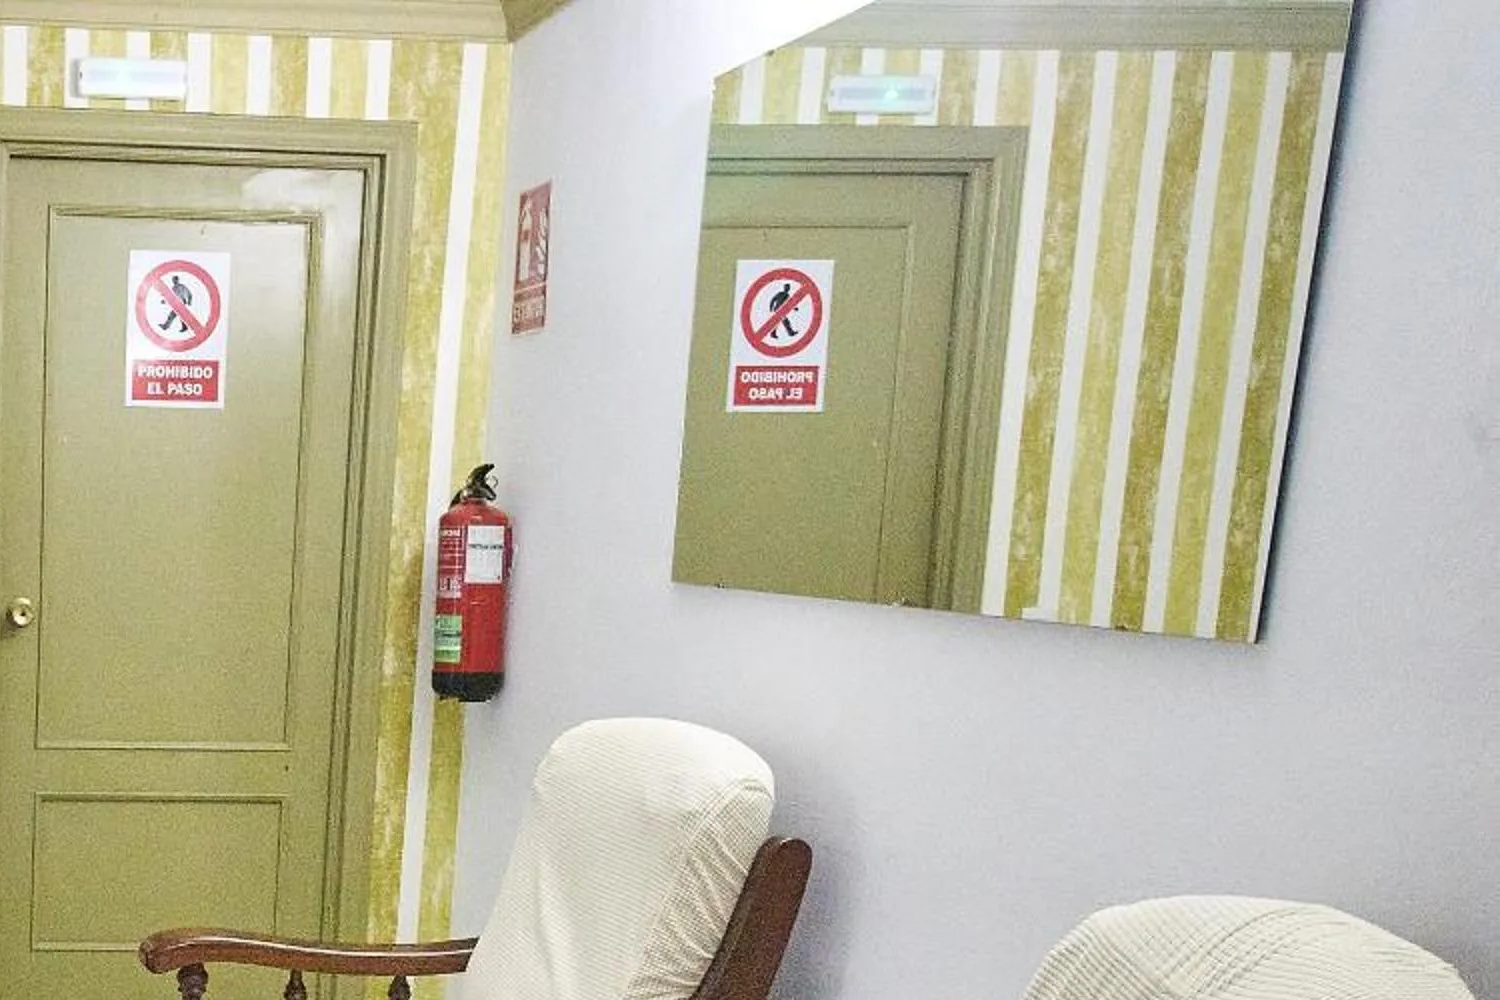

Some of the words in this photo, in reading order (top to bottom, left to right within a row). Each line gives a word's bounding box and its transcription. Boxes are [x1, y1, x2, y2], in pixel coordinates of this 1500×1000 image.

[137, 364, 213, 379] PROHIBIDO
[147, 381, 164, 395] EL
[167, 382, 203, 396] PASO
